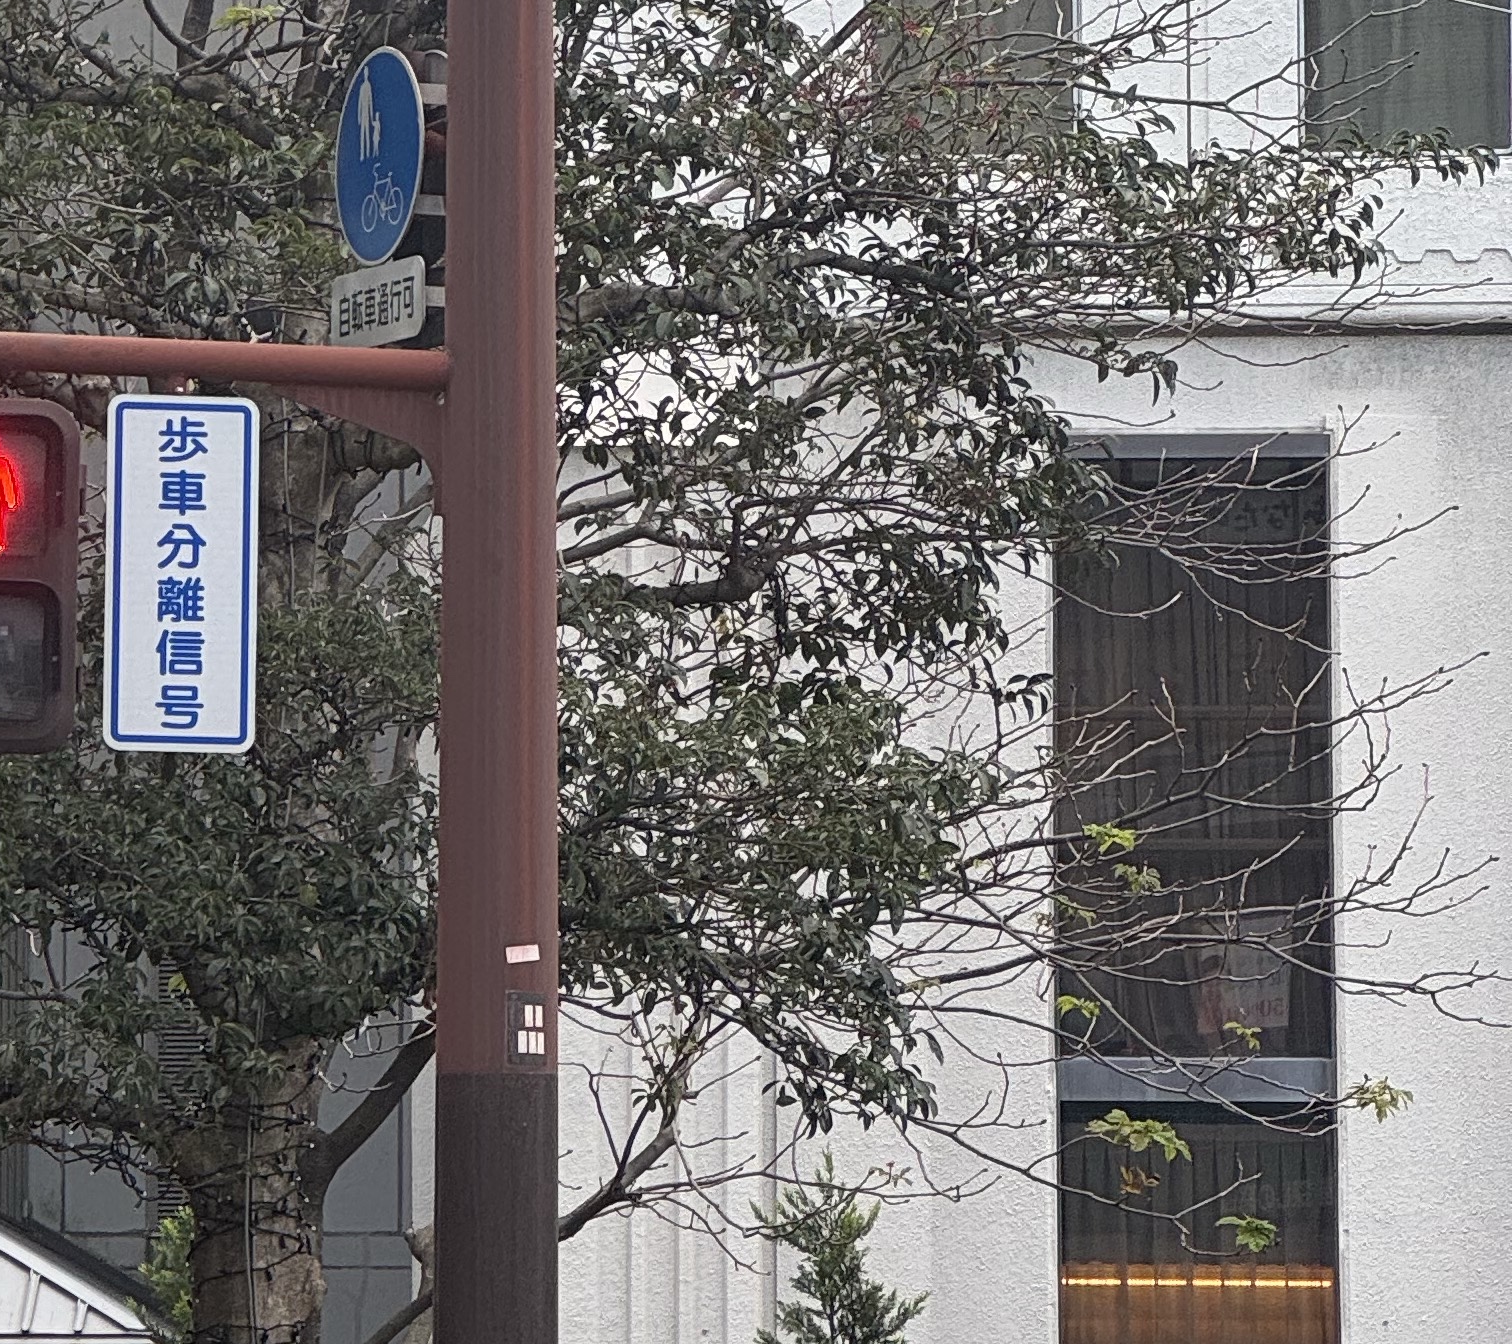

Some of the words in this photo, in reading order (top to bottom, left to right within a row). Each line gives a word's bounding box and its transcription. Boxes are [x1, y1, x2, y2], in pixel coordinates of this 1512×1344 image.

[339, 275, 415, 337] 自転車通行可
[155, 416, 208, 729] 歩車分離信号
